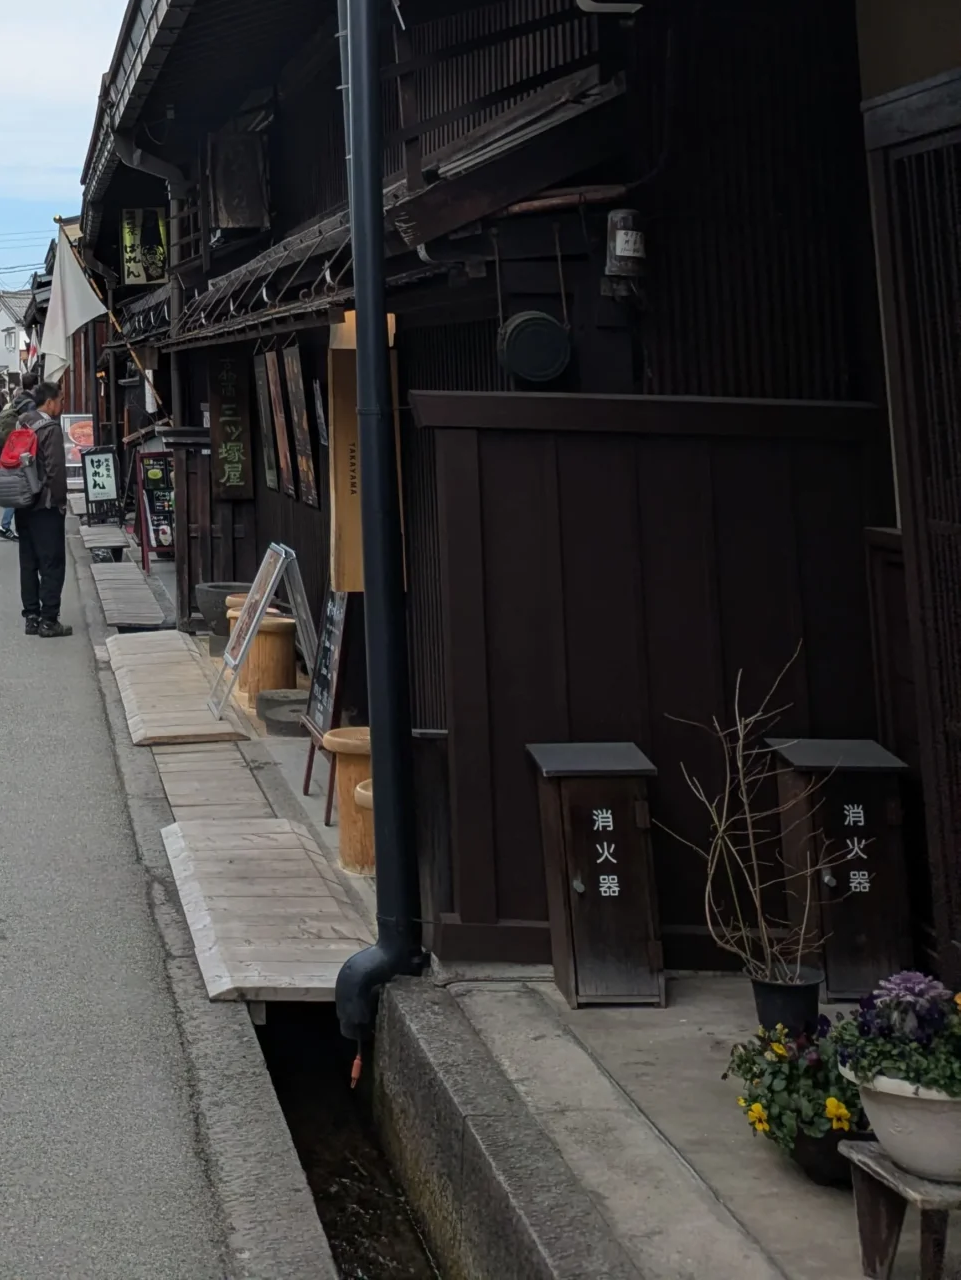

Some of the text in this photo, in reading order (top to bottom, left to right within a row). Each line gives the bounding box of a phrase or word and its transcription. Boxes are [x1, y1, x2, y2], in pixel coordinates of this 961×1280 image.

[90, 457, 106, 490] ばれん
[348, 441, 358, 496] TAKAYAMA
[592, 808, 621, 897] 消火器
[843, 803, 871, 892] 消火器
